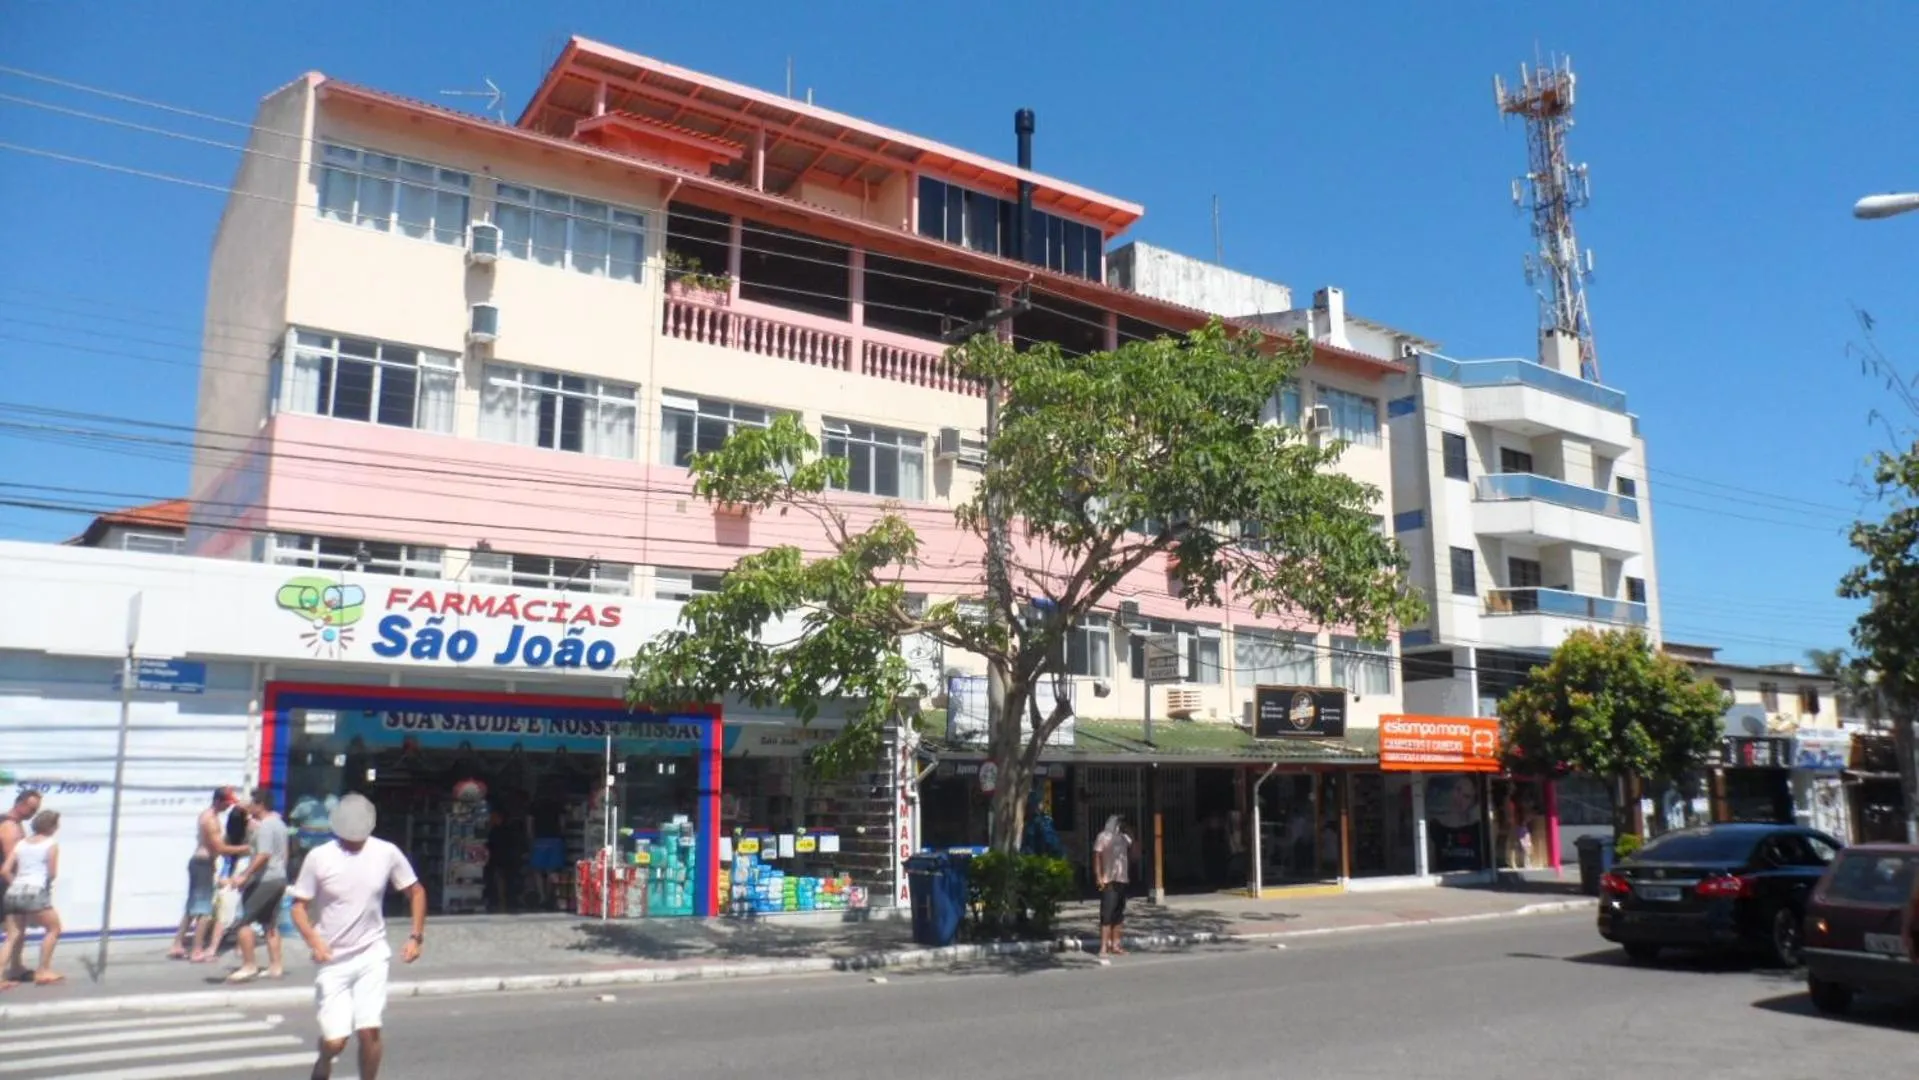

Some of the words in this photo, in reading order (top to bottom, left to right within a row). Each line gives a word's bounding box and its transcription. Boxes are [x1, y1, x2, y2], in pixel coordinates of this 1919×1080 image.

[385, 588, 622, 627] FARMÁCIAS
[371, 614, 478, 662] São
[493, 624, 616, 670] João
